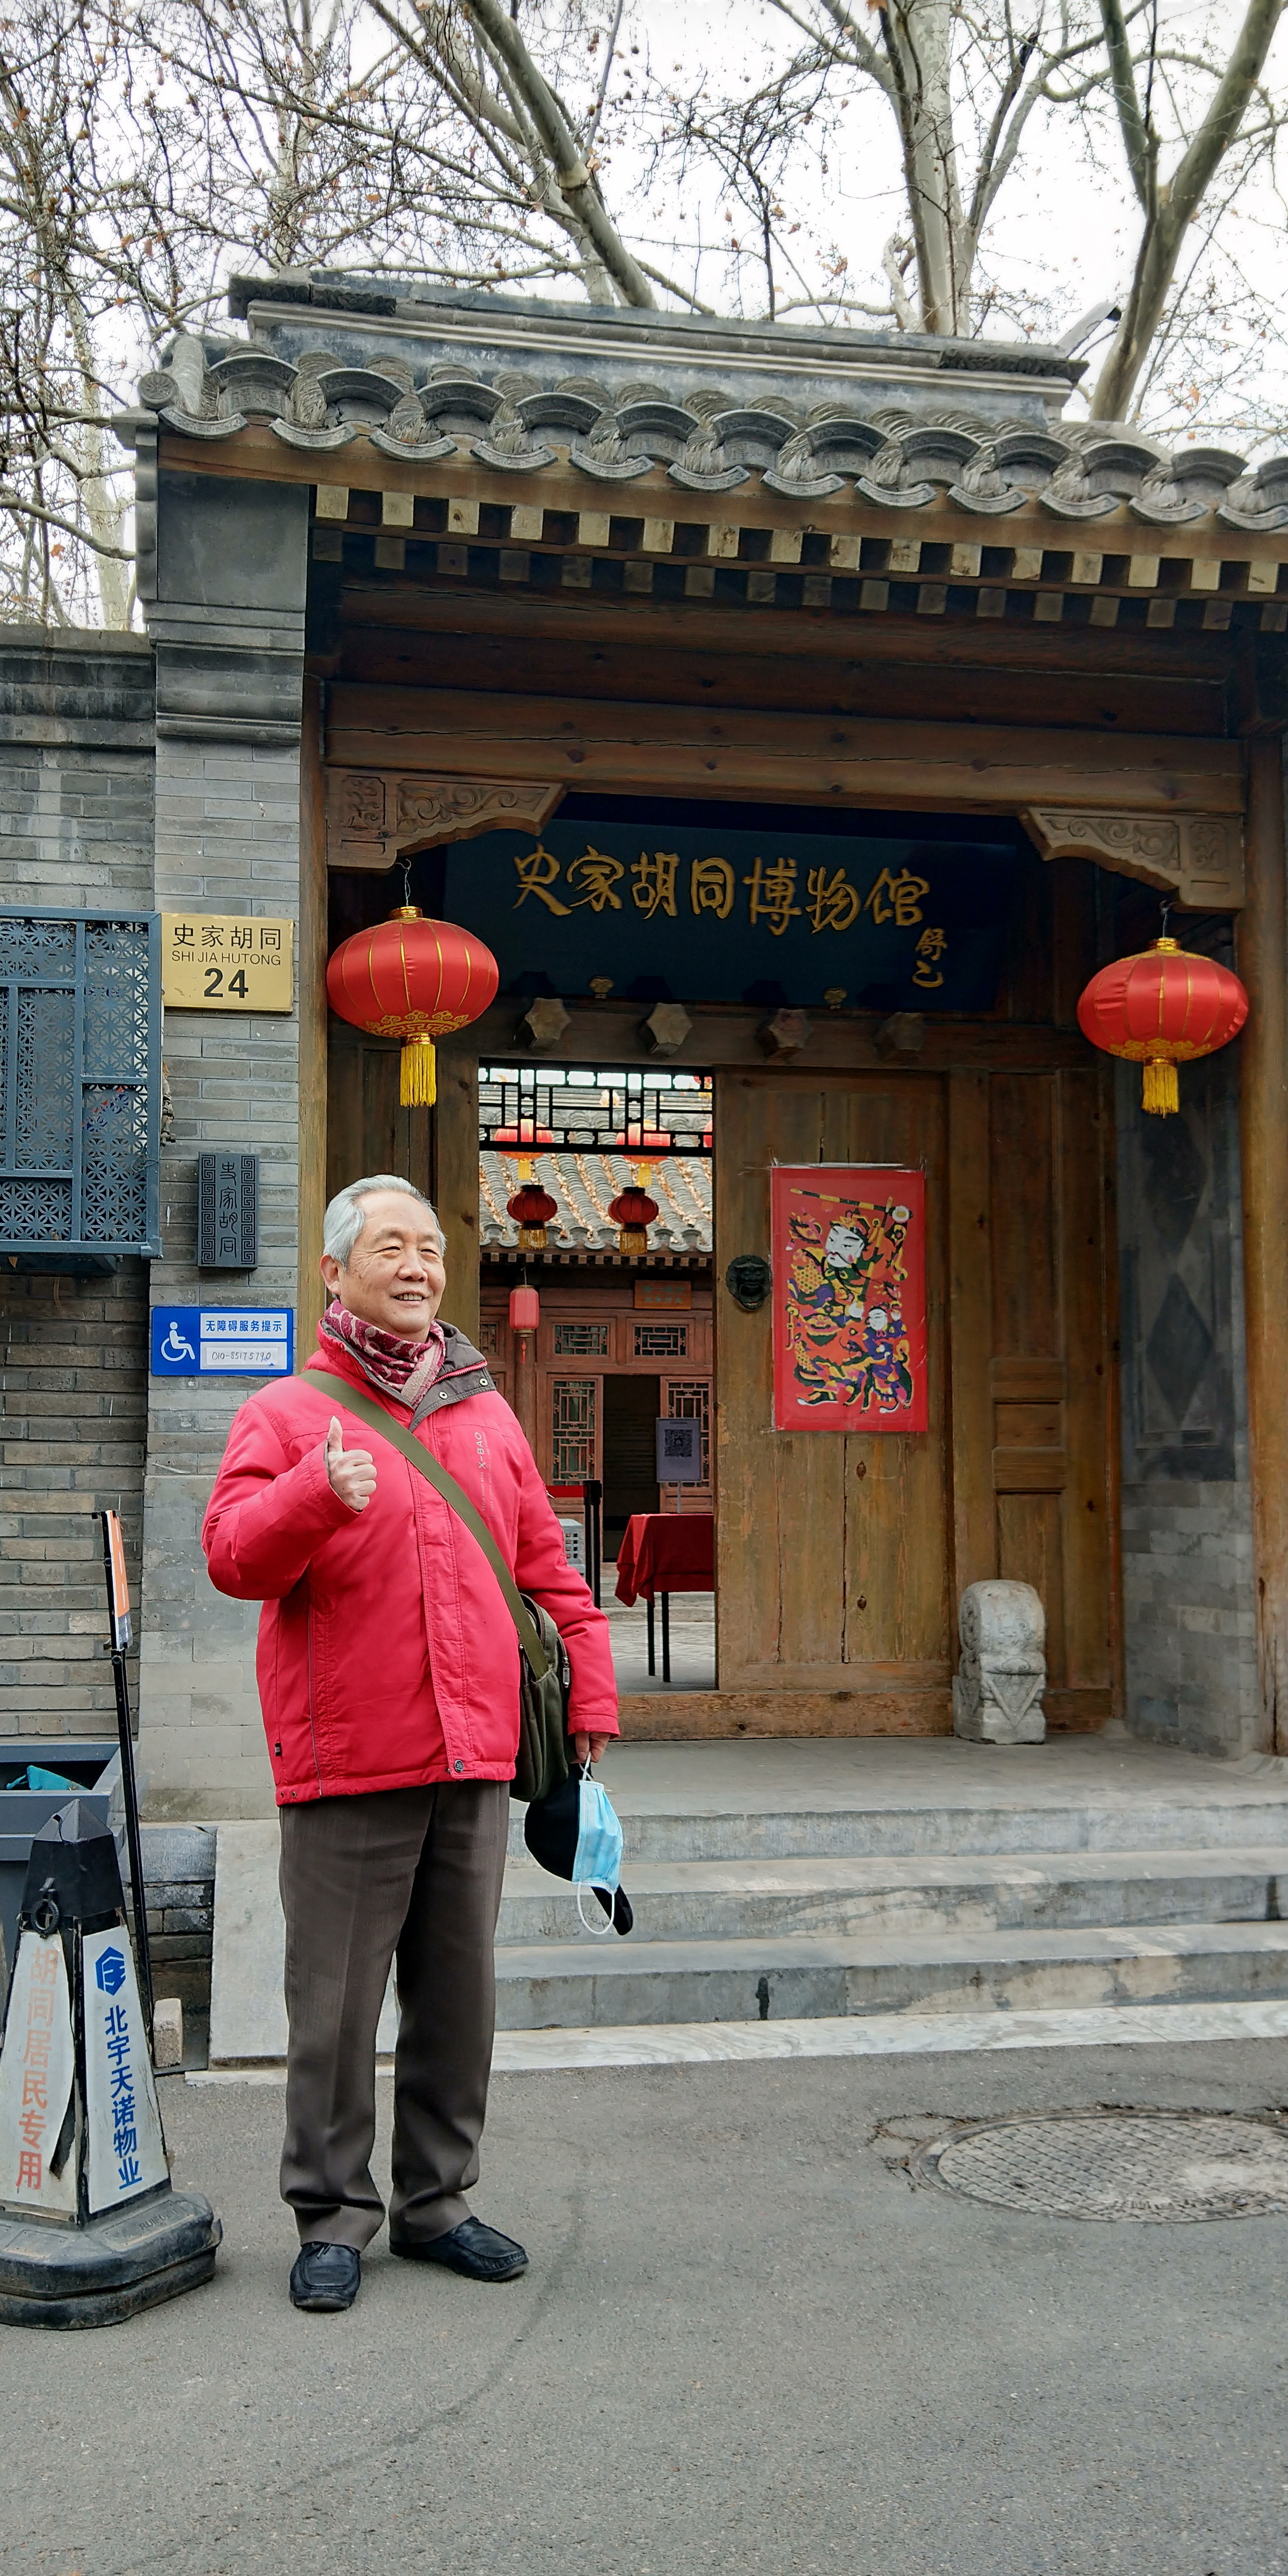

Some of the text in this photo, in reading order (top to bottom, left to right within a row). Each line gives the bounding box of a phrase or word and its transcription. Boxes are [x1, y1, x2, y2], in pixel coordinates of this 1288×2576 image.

[512, 843, 930, 935] 史家胡同博物馆
[172, 923, 281, 950] 史家胡同
[172, 950, 281, 965] SHI JIA HUTONG
[204, 968, 248, 998] 24
[219, 1161, 238, 1258] 史家胡同
[206, 1320, 282, 1331] 无障碍服务提示
[474, 1432, 487, 1469] X-BAO
[16, 1946, 60, 2190] 胡同居民专用
[105, 2005, 142, 2190] 北宇天诺物业
